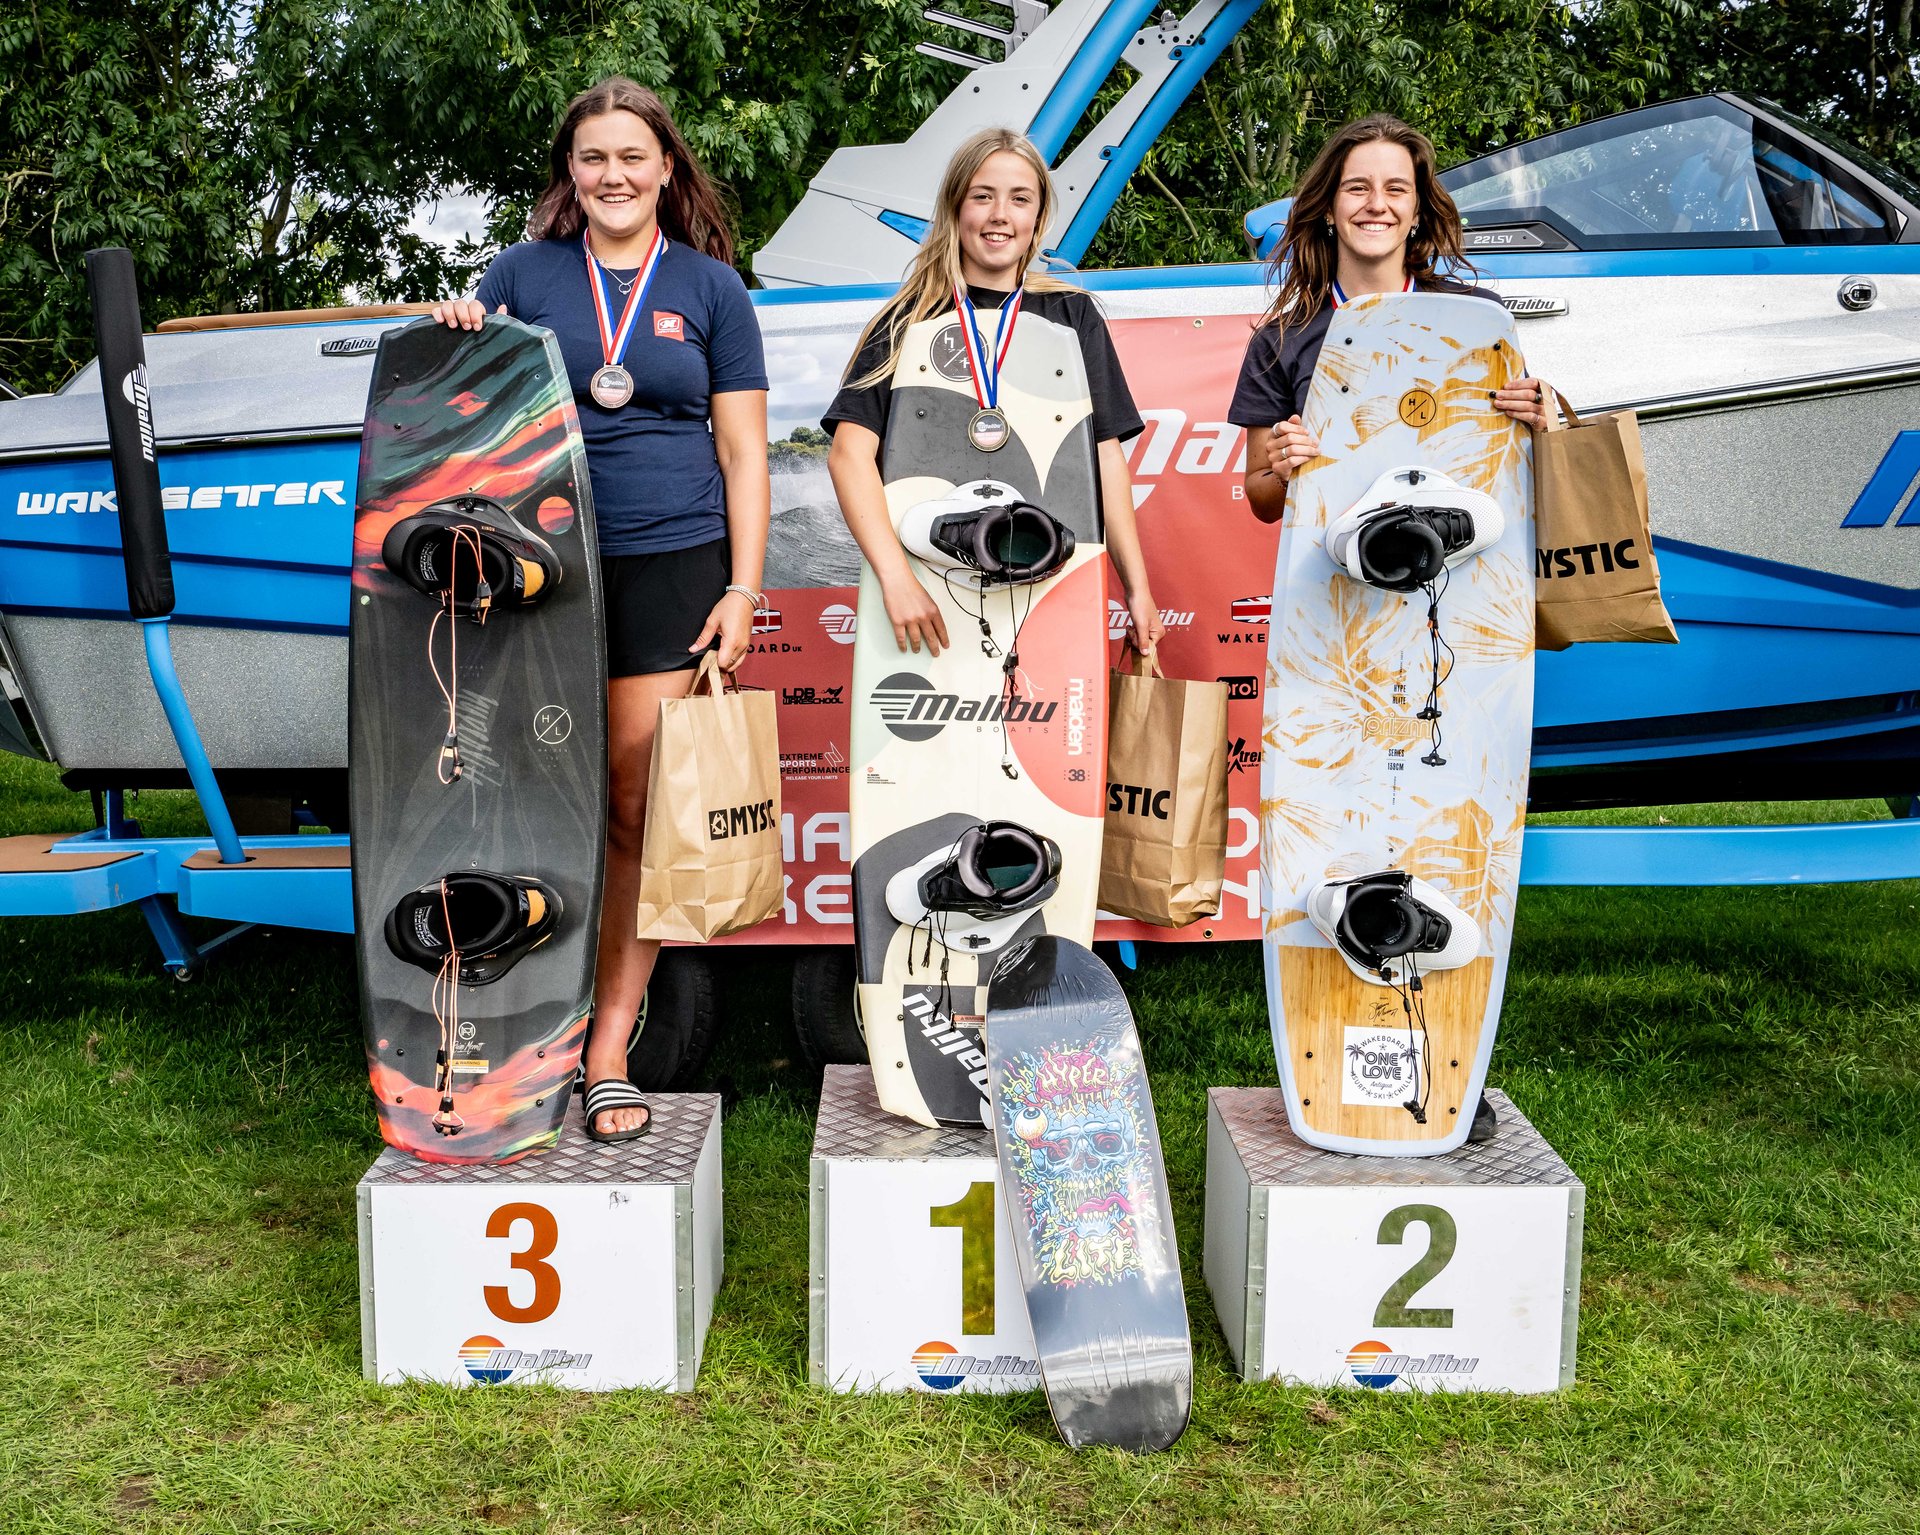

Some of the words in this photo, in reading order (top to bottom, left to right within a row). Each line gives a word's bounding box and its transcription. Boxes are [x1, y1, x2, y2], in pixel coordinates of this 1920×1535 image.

[1503, 299, 1555, 310] Malibu
[329, 339, 376, 351] Malibu
[134, 383, 154, 463] Malibu
[1536, 539, 1640, 579] YSTIC
[782, 688, 815, 698] LDB
[1393, 684, 1406, 692] HYPE
[782, 697, 844, 705] WAKESCHOOL
[907, 694, 1059, 722] Malibu
[541, 714, 550, 723] H
[1068, 678, 1086, 756] maiden
[555, 727, 562, 736] L
[976, 726, 1049, 734] BOATS
[779, 753, 823, 761] EXTREME
[1388, 748, 1404, 757] SERIES
[780, 760, 817, 768] SPORTS
[1068, 769, 1086, 782] 38
[1360, 1035, 1405, 1050] WAKEBOARD
[1365, 1051, 1399, 1067] ONE
[1036, 1051, 1109, 1094] HYPER
[1362, 1065, 1402, 1081] LOVE
[1351, 1075, 1367, 1092] SURF
[1370, 1081, 1393, 1090] Antigua
[483, 1202, 561, 1324] 3
[930, 1181, 995, 1335] 1
[1051, 1237, 1141, 1283] LITE
[1373, 1203, 1457, 1328] 2
[485, 1348, 593, 1370] Malibu
[938, 1355, 1042, 1376] Malibu
[1371, 1353, 1480, 1374] Malibu
